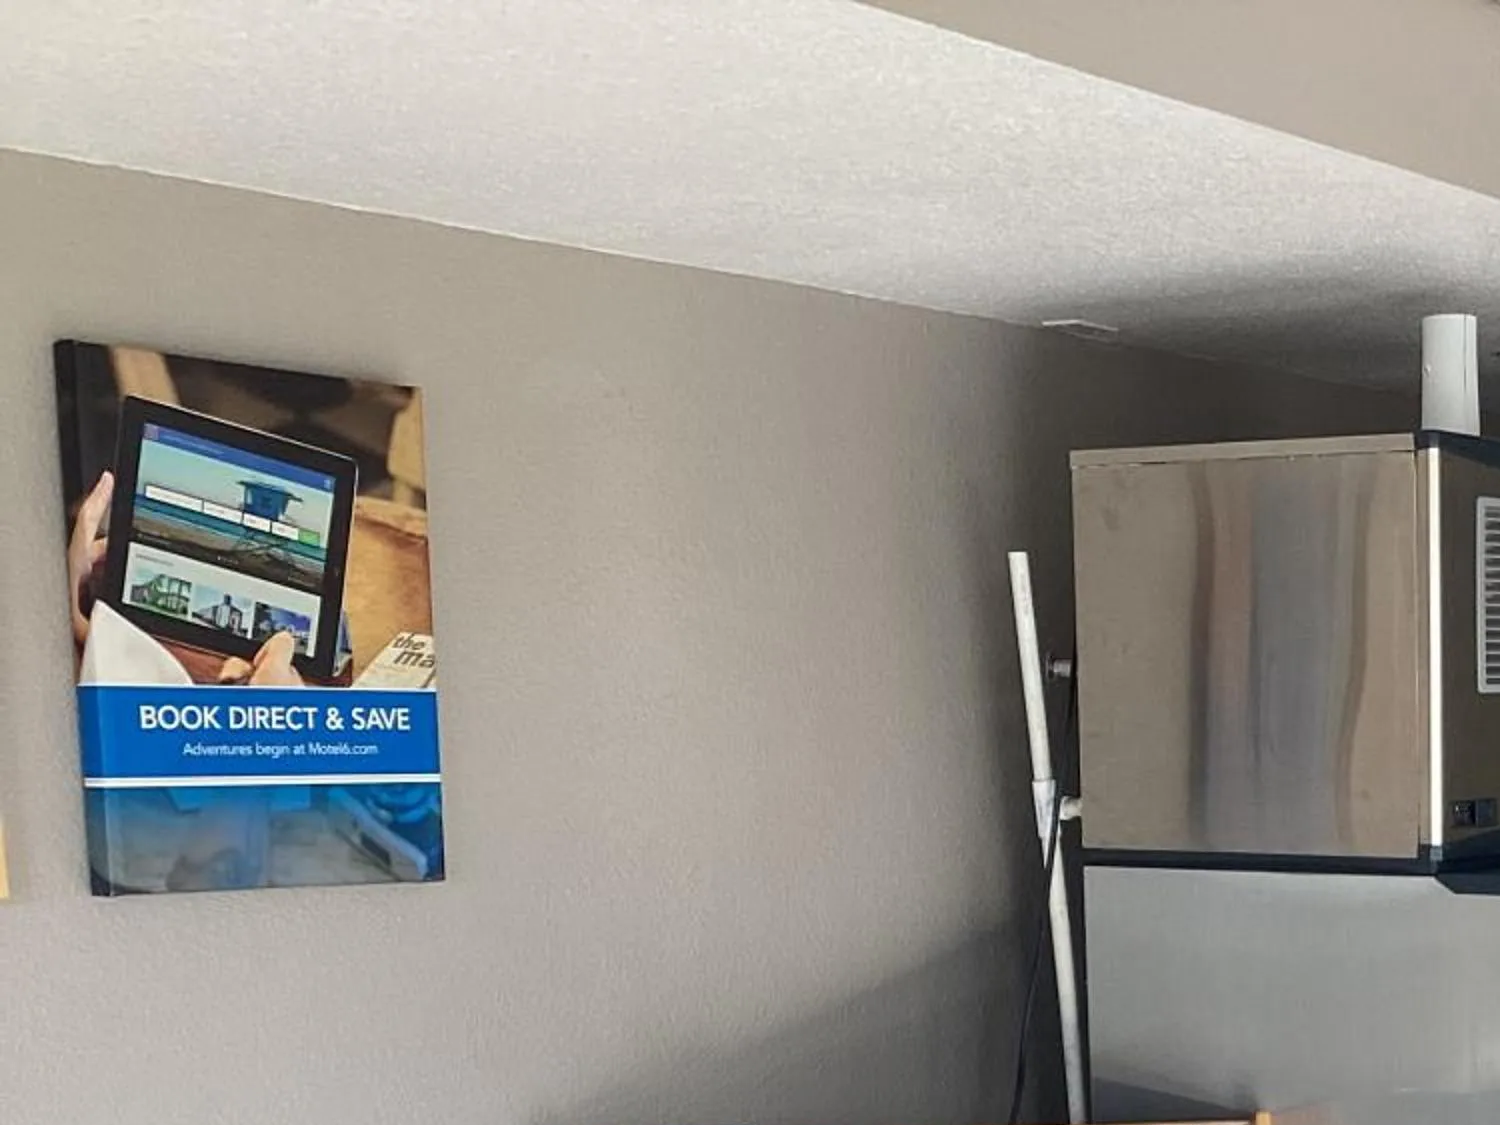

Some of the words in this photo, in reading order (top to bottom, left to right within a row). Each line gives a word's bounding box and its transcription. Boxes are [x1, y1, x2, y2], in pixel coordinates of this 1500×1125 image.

[391, 632, 425, 651] the
[139, 704, 221, 730] BOOK
[229, 705, 318, 731] DIRECT
[325, 707, 345, 731] &
[351, 707, 411, 732] SAVE
[182, 742, 253, 756] Adventures
[255, 742, 291, 759] begin
[293, 743, 306, 756] at
[308, 741, 379, 756] Motel6.com
